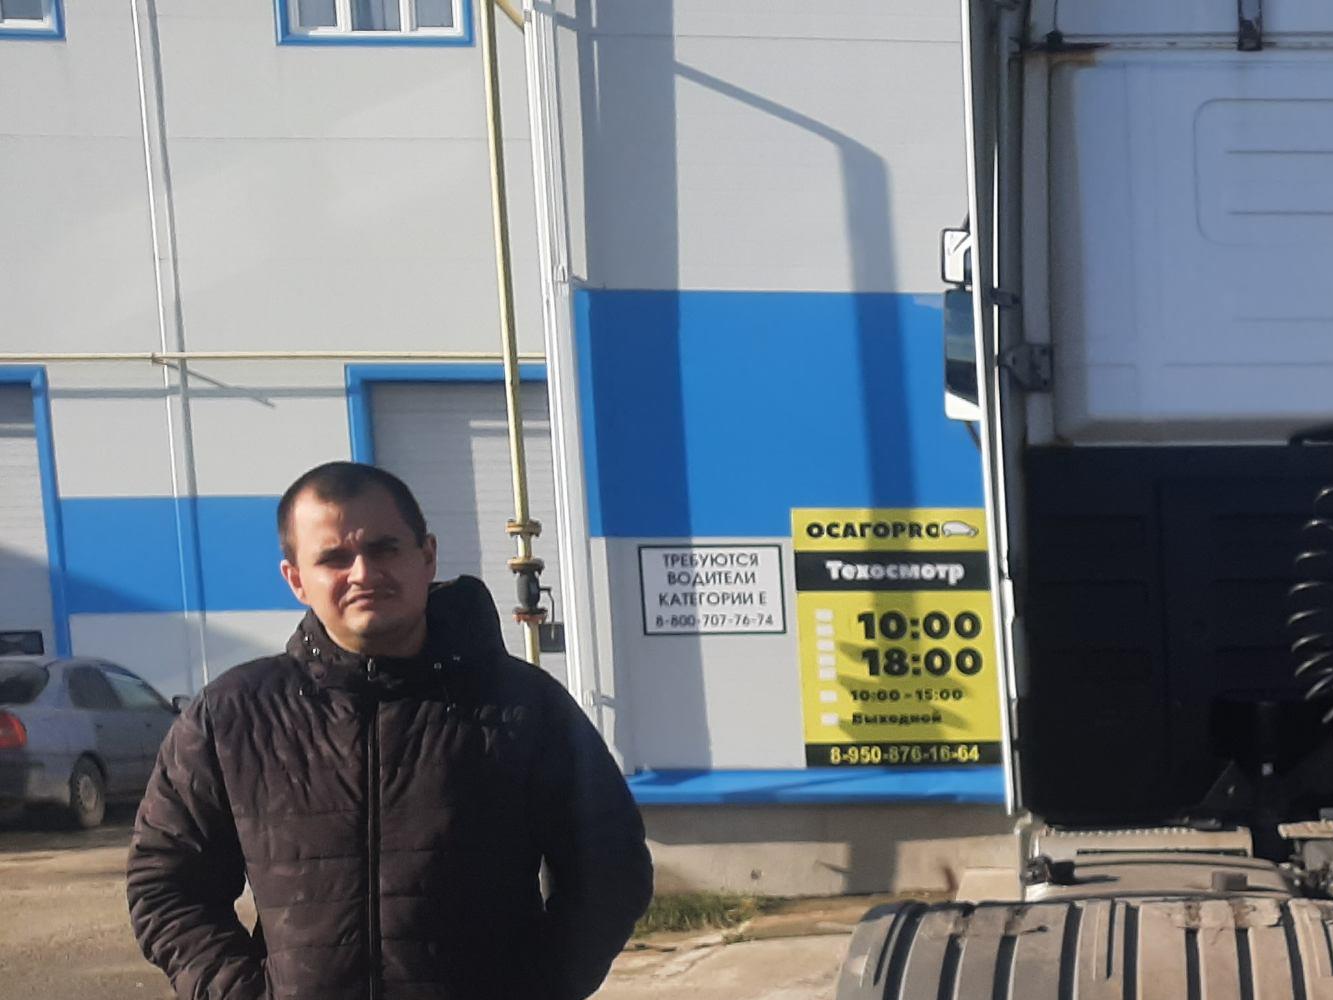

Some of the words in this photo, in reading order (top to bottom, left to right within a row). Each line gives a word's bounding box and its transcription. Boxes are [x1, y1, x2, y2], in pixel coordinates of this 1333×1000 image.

[662, 553, 759, 568] ТРЕБУЮТСЯ
[667, 571, 756, 587] ВОДИТЕЛИ
[825, 560, 965, 585] Техосмотр
[658, 591, 754, 607] КАТЕГОРИИ
[656, 613, 774, 628] 8-800-707-76-74
[857, 610, 982, 640] 10:00
[861, 647, 983, 677] 18:00
[851, 711, 943, 725] Выходной
[830, 744, 980, 765] 8-950-876-16-64
